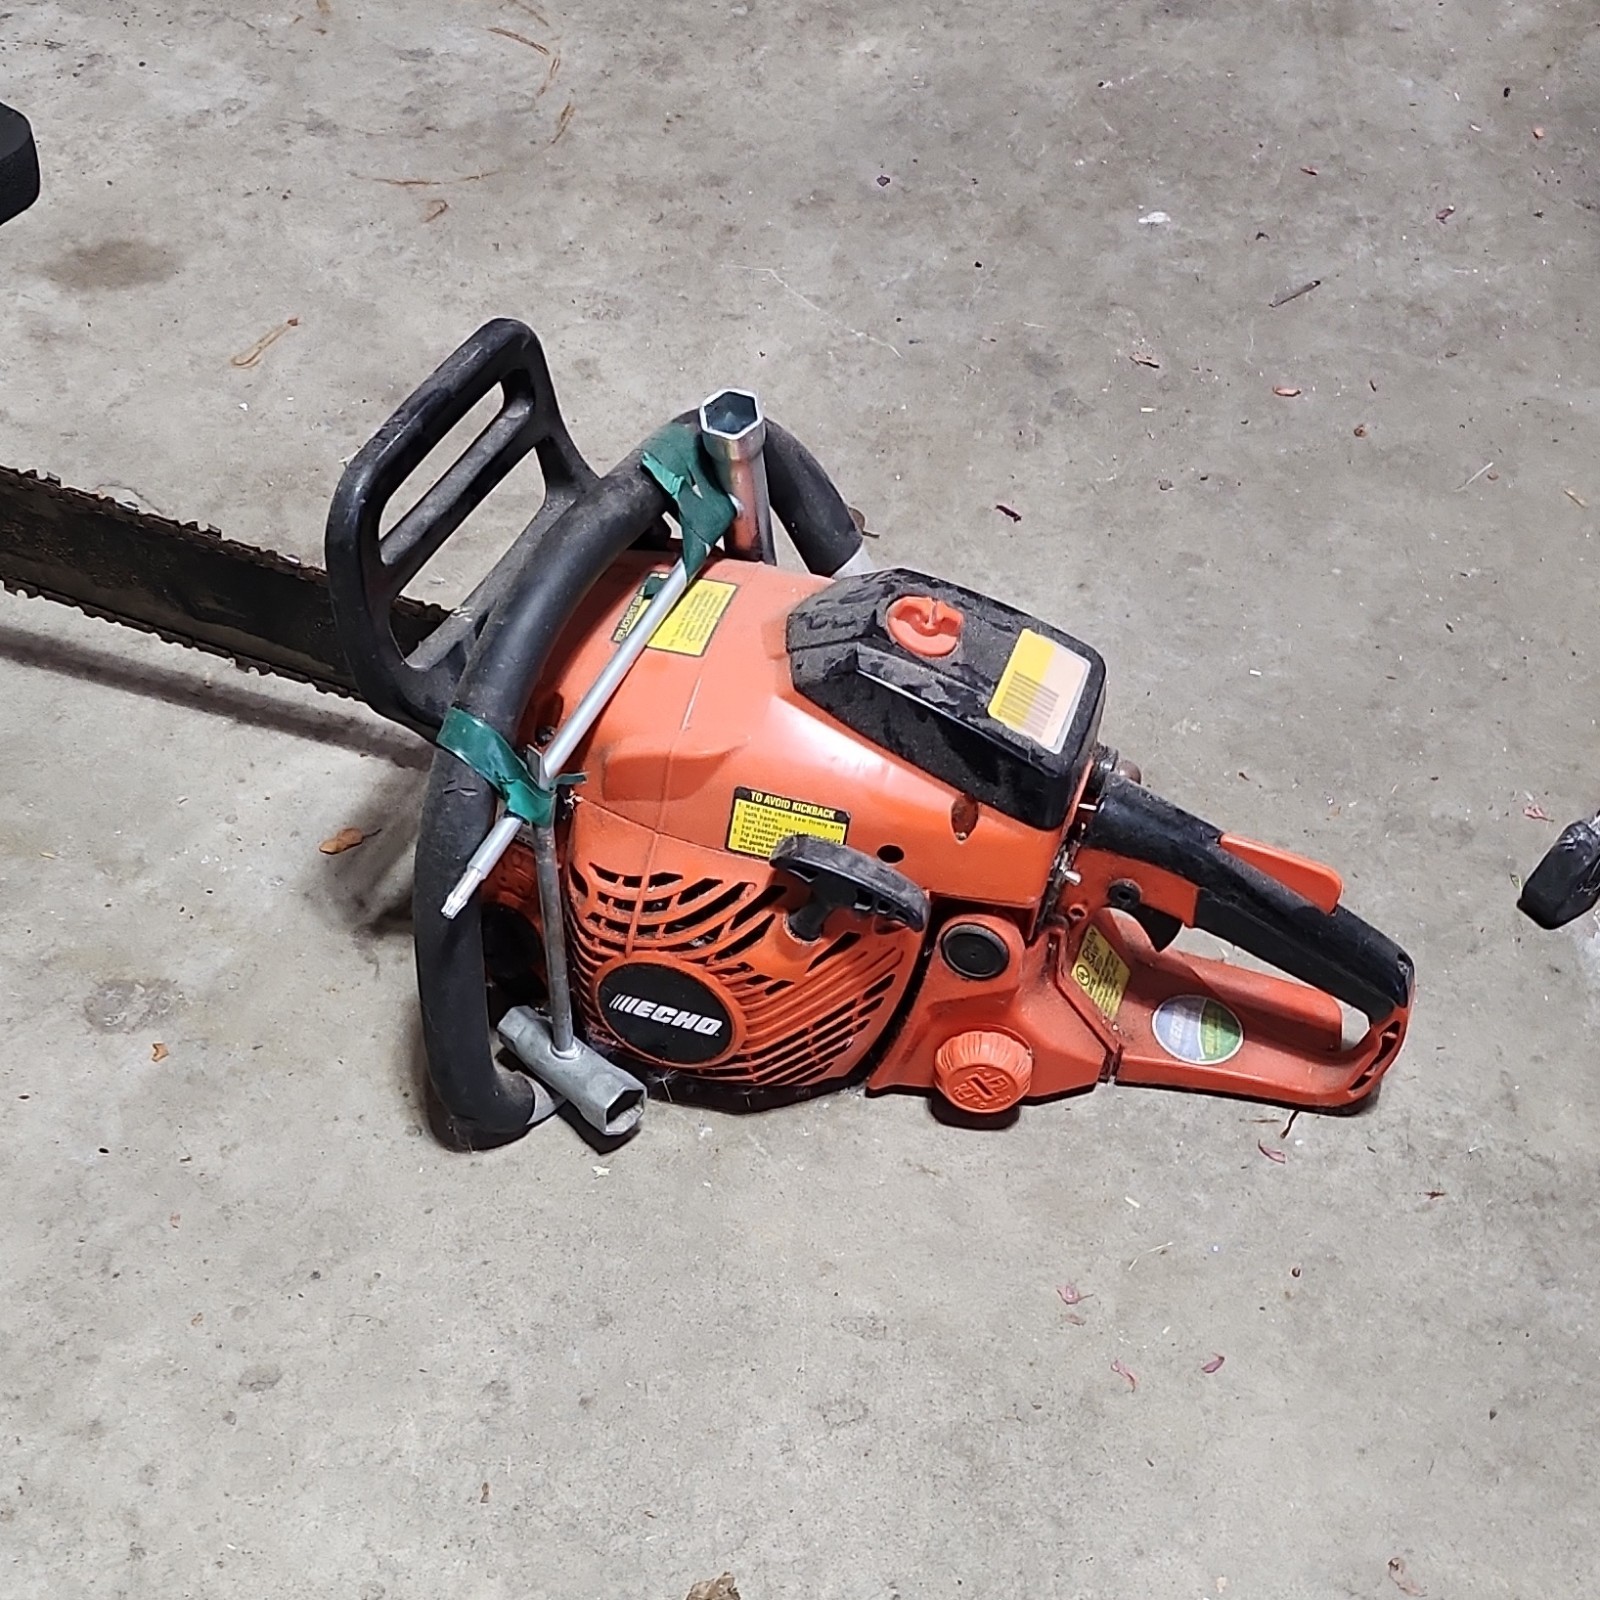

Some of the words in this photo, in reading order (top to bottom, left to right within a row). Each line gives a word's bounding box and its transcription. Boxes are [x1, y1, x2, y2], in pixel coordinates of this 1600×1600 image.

[751, 791, 763, 803] TO
[764, 795, 791, 809] AVOID
[792, 801, 836, 820] KICKBACK
[632, 1000, 723, 1036] ECHO
